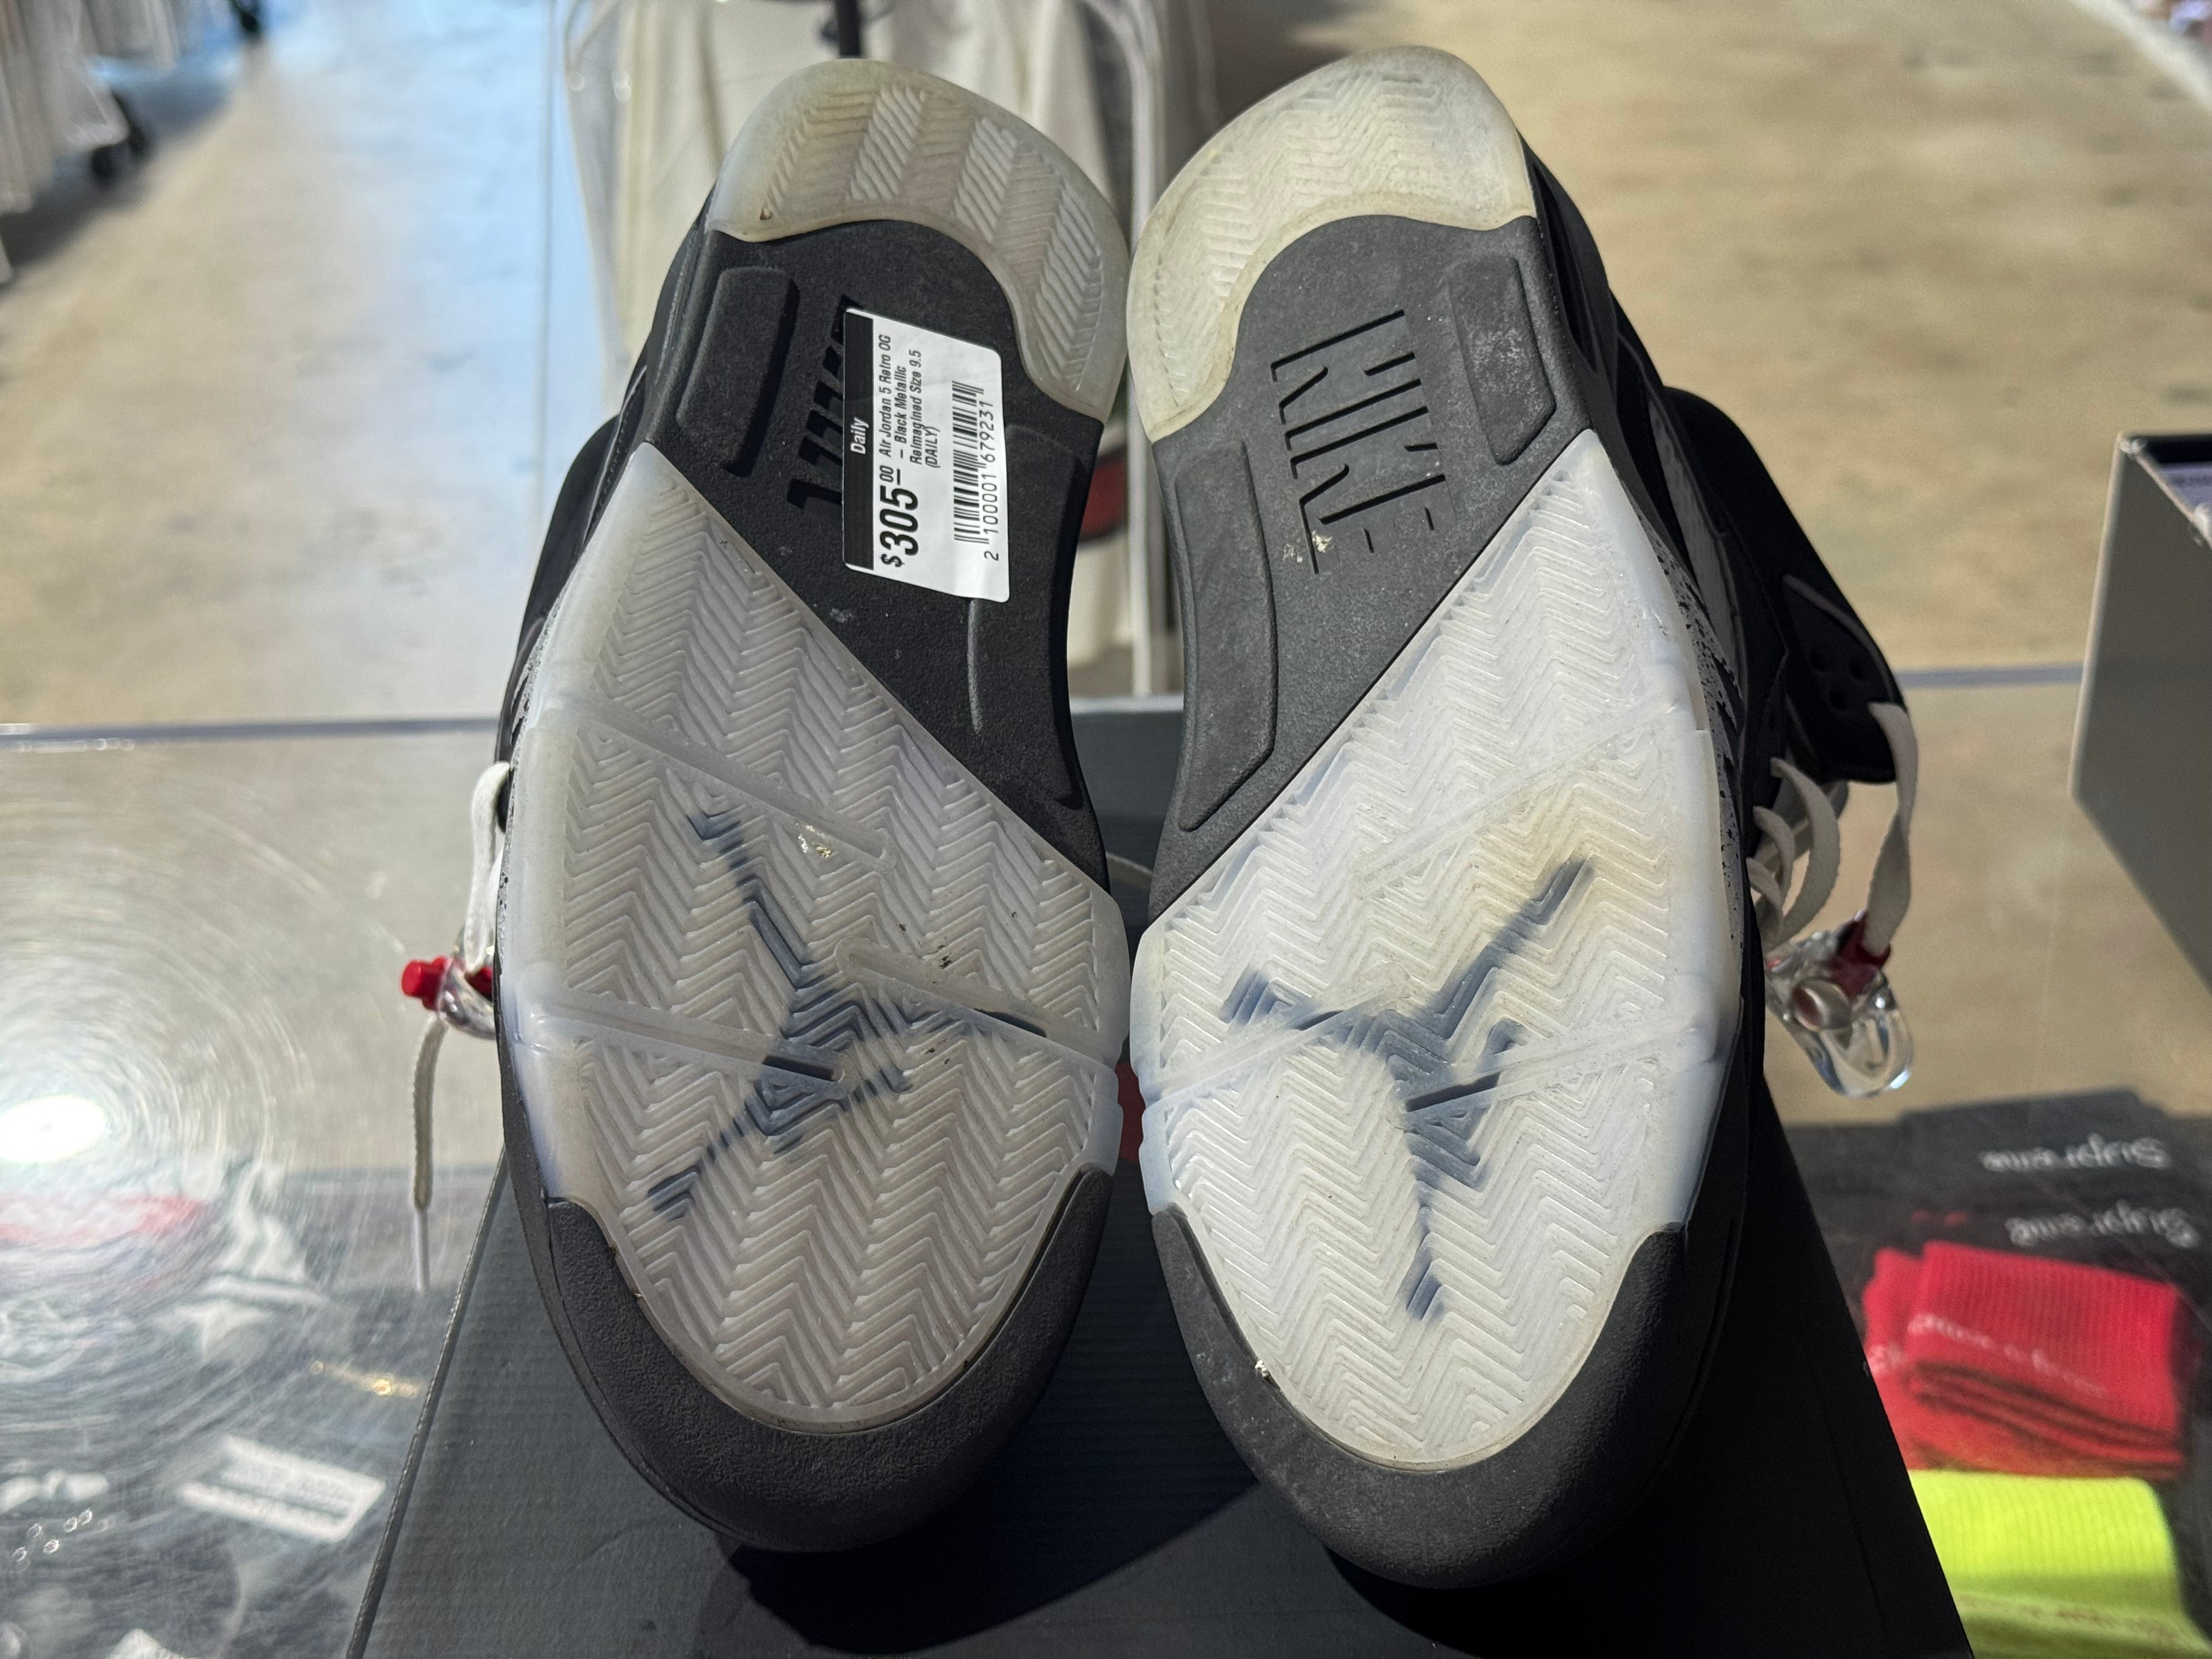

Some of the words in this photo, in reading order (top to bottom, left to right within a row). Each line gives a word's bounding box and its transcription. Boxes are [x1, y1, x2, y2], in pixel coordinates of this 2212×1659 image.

[878, 335, 891, 351] OG
[909, 349, 921, 368] 9.5
[879, 354, 891, 383] Retro
[909, 371, 921, 393] Size
[879, 386, 891, 394] 5
[894, 366, 907, 409] Metallic
[878, 399, 891, 437] Jordan
[894, 412, 907, 444] Black
[910, 396, 924, 465] Reimagined
[850, 417, 869, 454] Daily
[878, 439, 891, 458] Air
[923, 426, 940, 468] (DAILY)
[1271, 309, 1456, 574] NIKE
